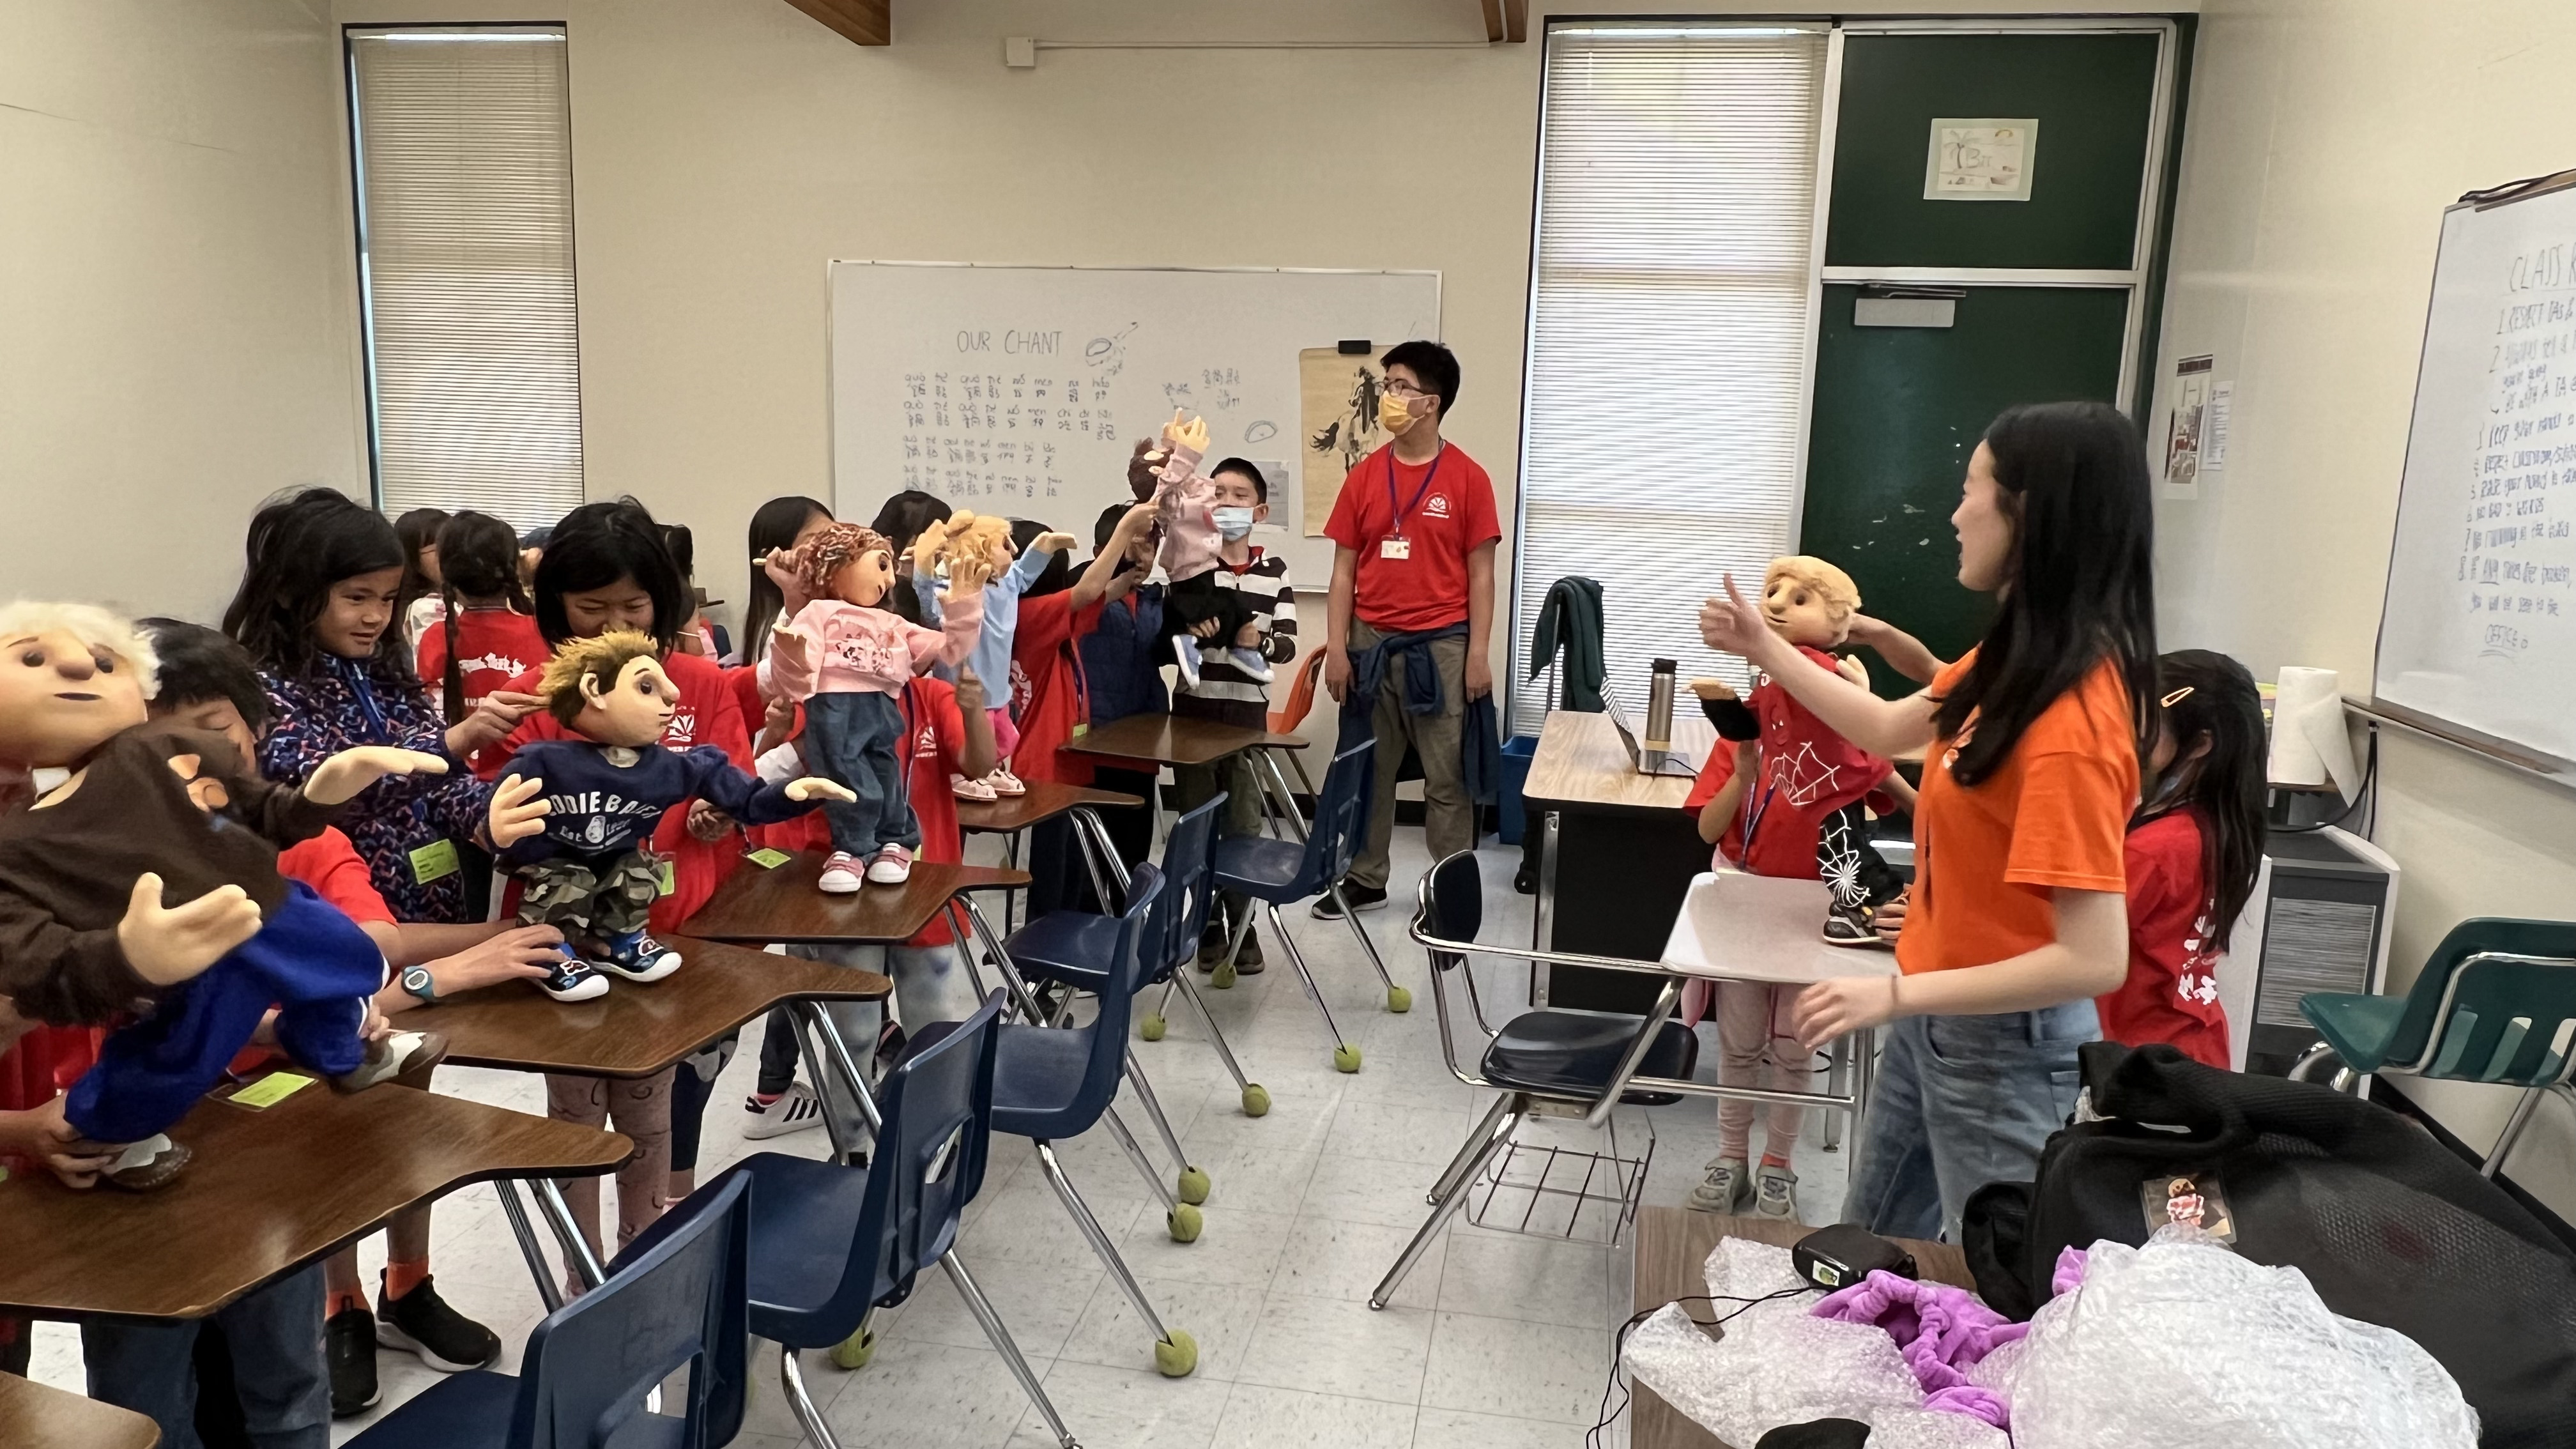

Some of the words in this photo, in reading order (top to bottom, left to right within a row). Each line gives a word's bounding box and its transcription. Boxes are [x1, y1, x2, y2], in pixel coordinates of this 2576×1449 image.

[2510, 243, 2564, 292] CLASS
[958, 331, 990, 352] OUR
[1005, 330, 1062, 355] CHANT
[549, 791, 601, 816] DDIE
